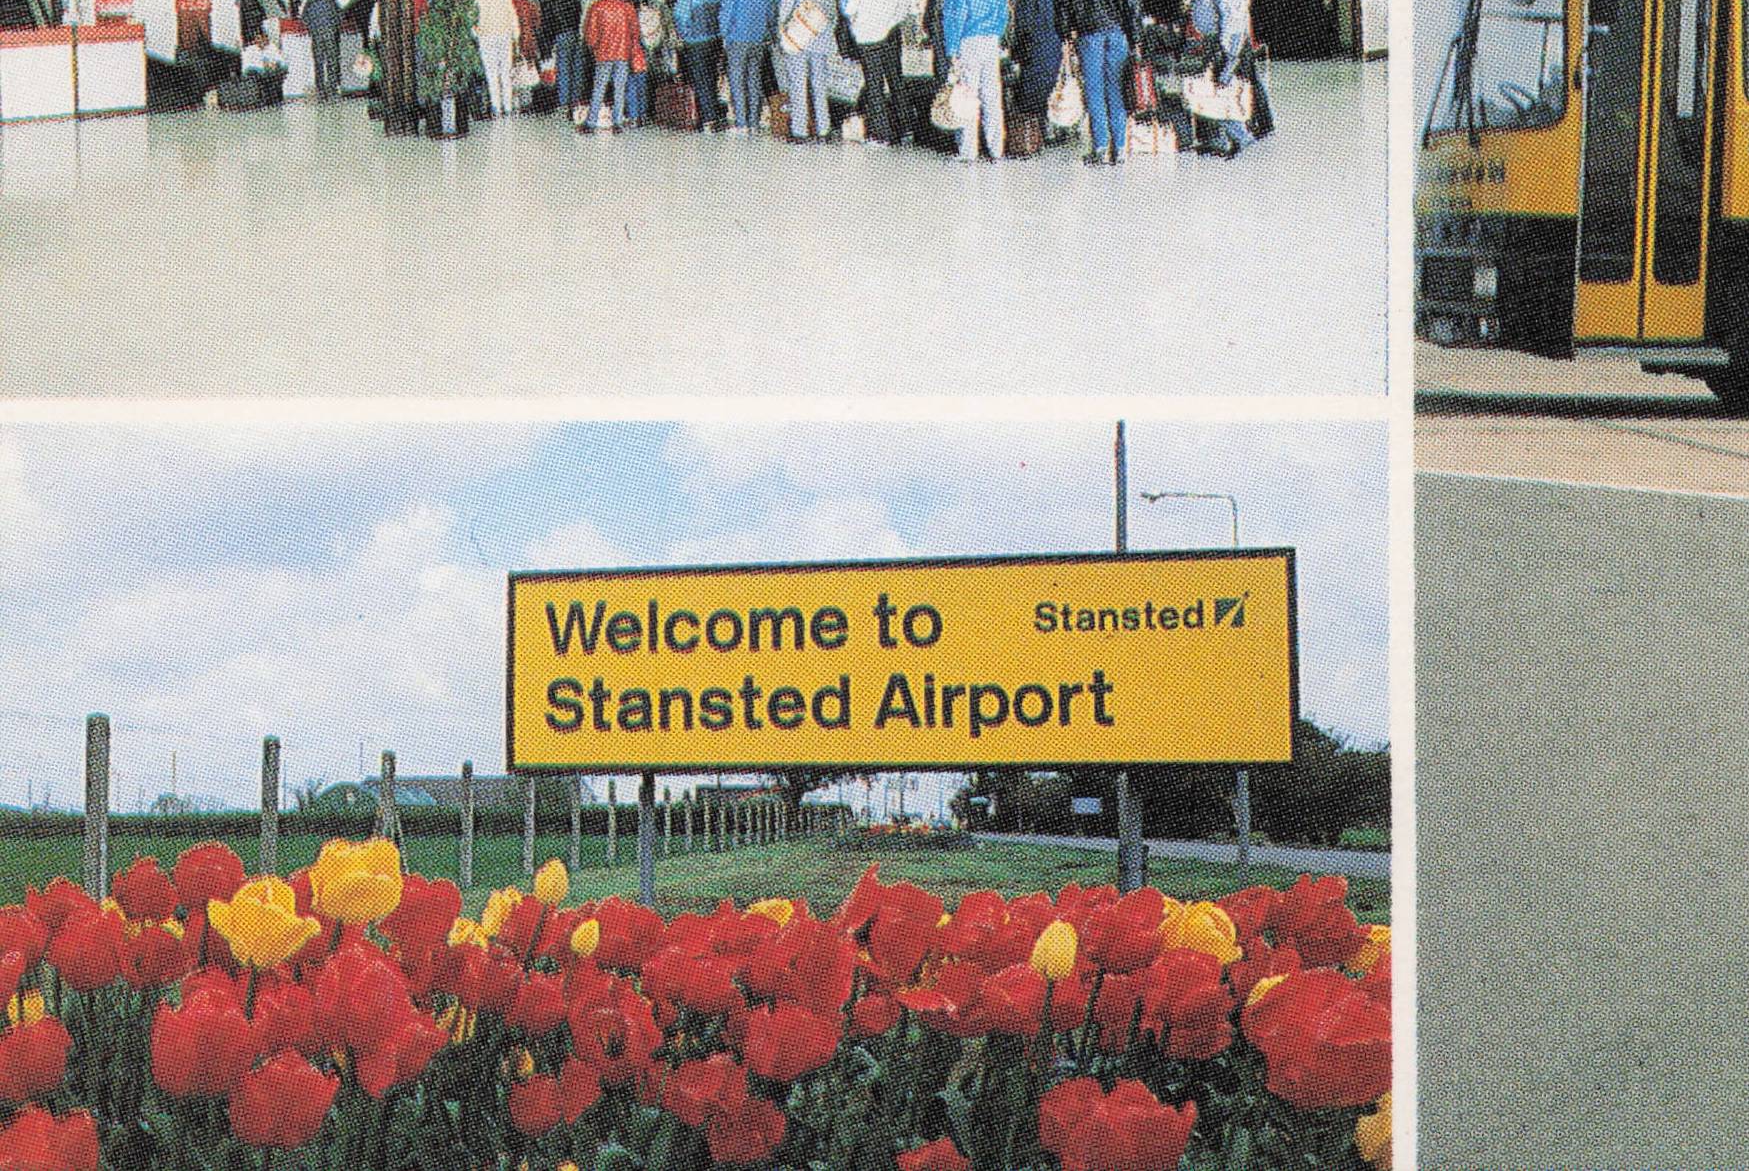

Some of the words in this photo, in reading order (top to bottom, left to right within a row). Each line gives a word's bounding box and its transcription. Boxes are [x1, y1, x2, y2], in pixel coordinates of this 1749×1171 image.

[546, 599, 848, 655] Welcome
[874, 592, 943, 649] to
[1034, 599, 1204, 633] Stansted
[545, 674, 850, 732] Stansted
[874, 669, 1114, 738] Airport
